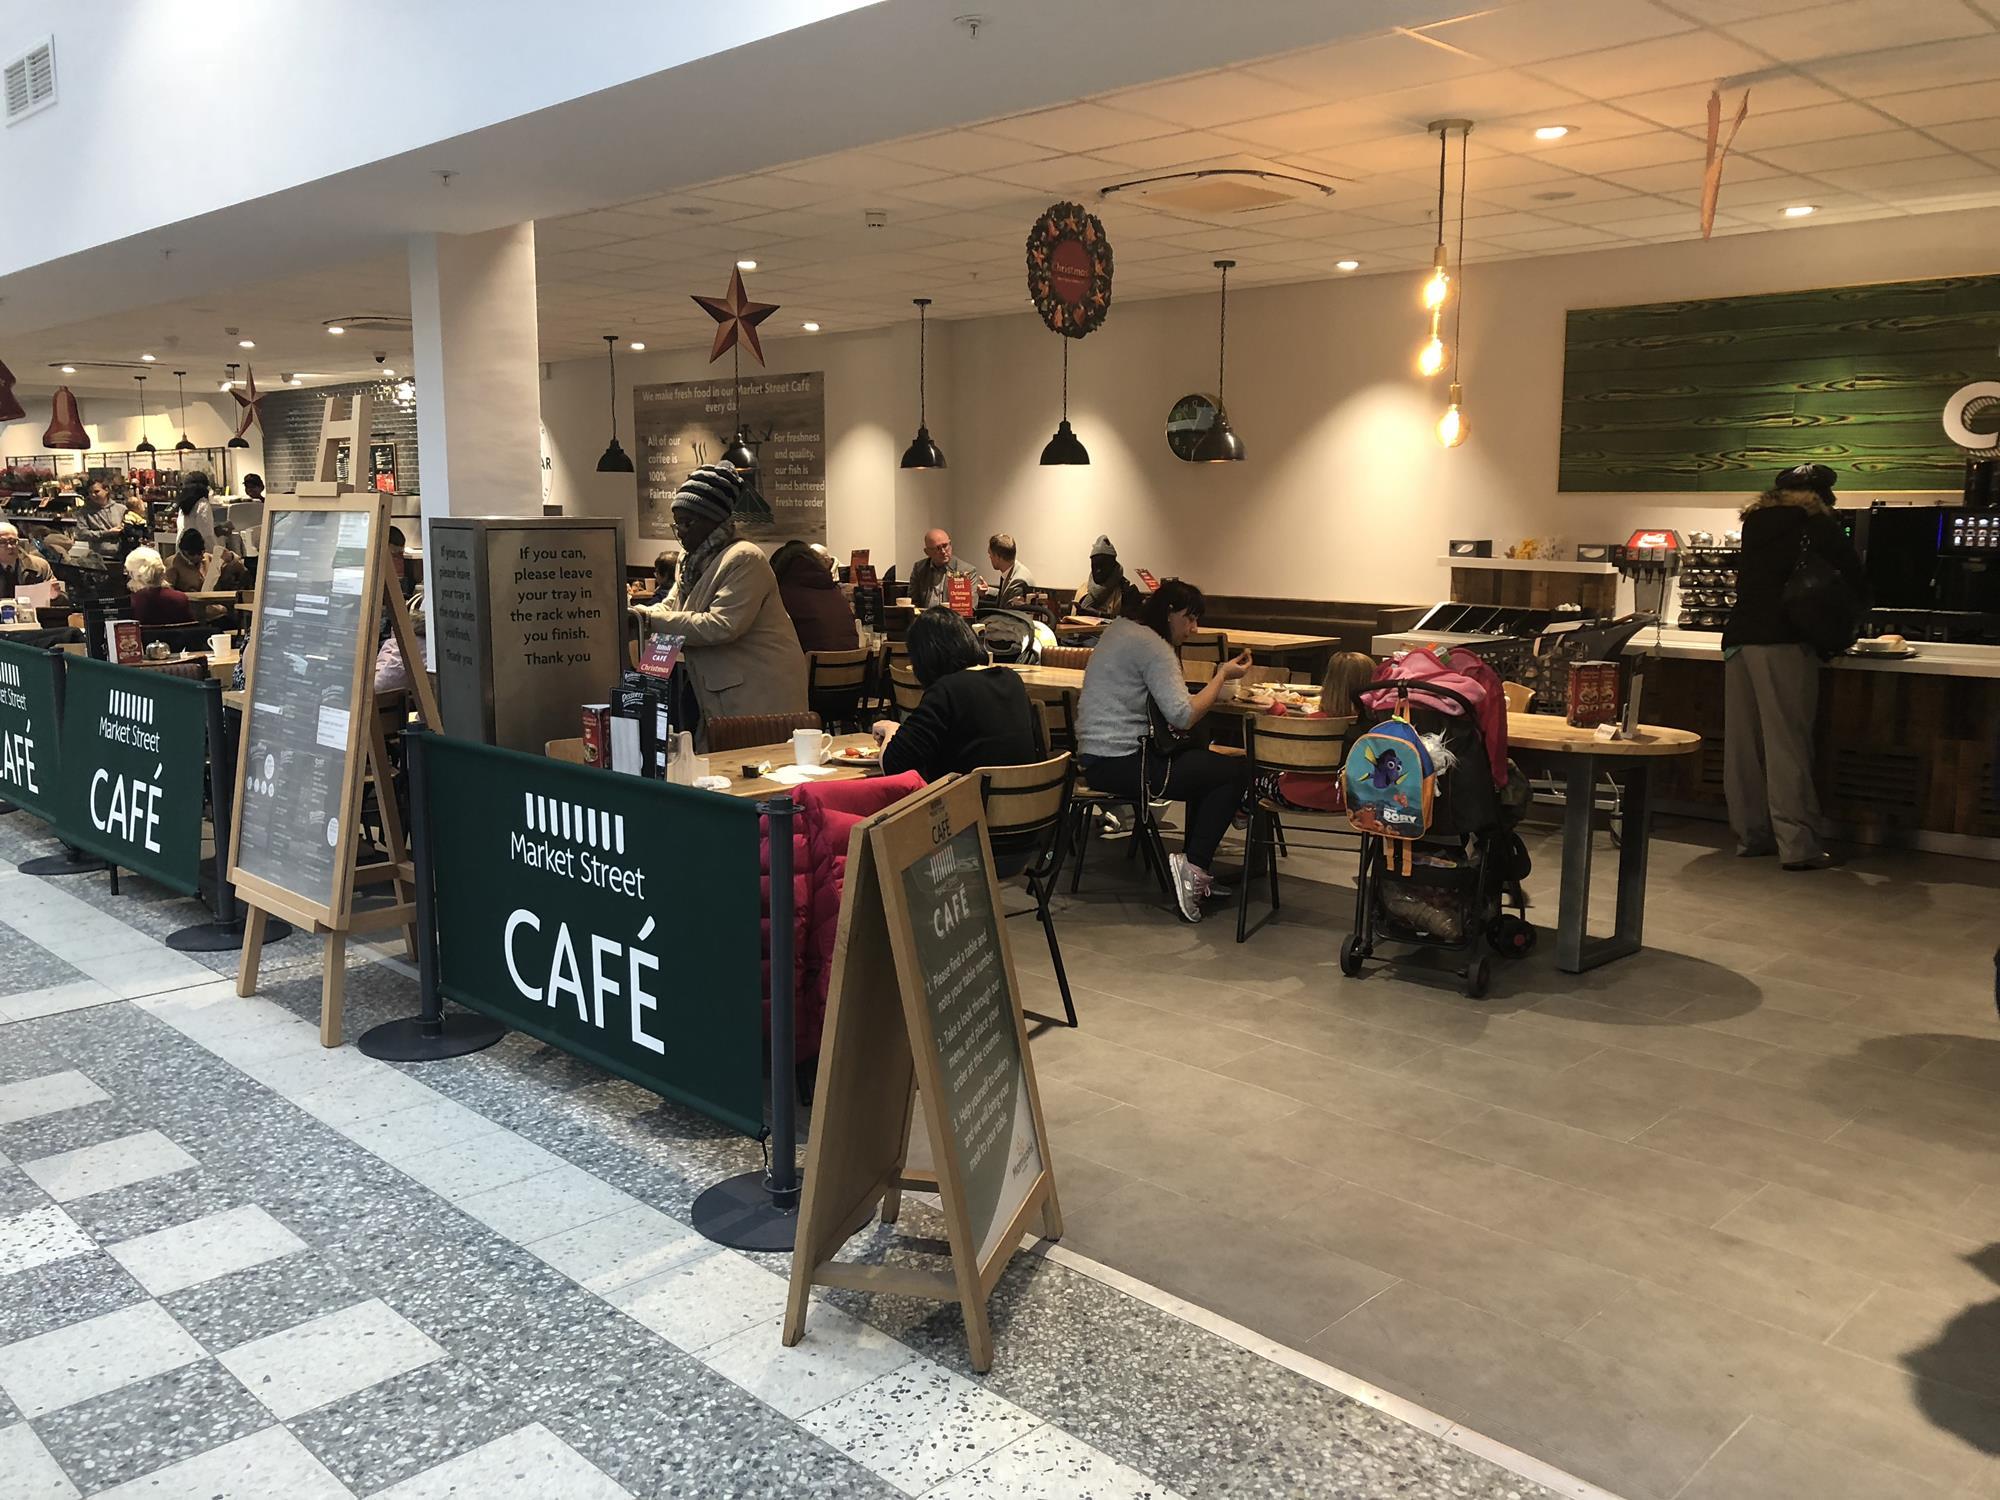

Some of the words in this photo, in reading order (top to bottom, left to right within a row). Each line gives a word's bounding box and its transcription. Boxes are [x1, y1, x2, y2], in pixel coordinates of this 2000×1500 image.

[642, 391, 654, 401] We
[654, 389, 673, 400] make
[674, 387, 692, 400] fresh
[694, 385, 712, 399] food
[712, 386, 720, 397] in
[720, 386, 734, 397] our
[765, 380, 790, 393] Street
[791, 379, 810, 392] Café
[705, 404, 725, 414] every
[726, 402, 740, 413] da
[648, 436, 658, 447] All
[659, 435, 668, 446] of
[668, 436, 681, 446] our
[774, 433, 785, 443] For
[786, 432, 820, 442] freshness
[648, 453, 671, 465] coffee
[671, 454, 678, 464] is
[774, 449, 788, 458] and
[649, 470, 667, 482] 100%
[775, 468, 787, 476] our
[788, 464, 802, 475] fish
[802, 464, 809, 475] is
[650, 488, 677, 500] Fairtrad
[775, 481, 794, 492] hand
[794, 480, 825, 492] battered
[775, 496, 794, 507] fresh
[794, 498, 804, 507] to
[804, 496, 824, 508] order
[520, 547, 529, 560] If
[532, 552, 558, 562] you
[560, 548, 586, 560] can,
[514, 568, 556, 584] please
[560, 566, 593, 579] leave
[518, 590, 548, 604] your
[551, 589, 578, 602] tray
[580, 587, 592, 599] in
[510, 608, 533, 622] the
[536, 608, 564, 621] rack
[566, 606, 601, 619] when
[524, 632, 548, 646] you
[551, 626, 590, 640] finish.
[524, 651, 564, 666] Thank
[567, 652, 591, 666] you
[640, 664, 670, 674] Christmas
[8, 693, 28, 712] Street
[99, 716, 130, 745] Market
[132, 724, 160, 753] Street
[0, 718, 39, 794] AFÉ
[90, 762, 163, 854] CAFÉ
[511, 831, 575, 879] Market
[580, 852, 646, 900] Street
[933, 882, 970, 938] CAFÉ
[933, 966, 951, 990] Please
[950, 951, 961, 972] find
[961, 952, 966, 962] a
[964, 938, 978, 959] table
[978, 928, 988, 948] and
[504, 908, 665, 1055] CAFÉ
[938, 993, 952, 1014] note
[951, 981, 963, 1005] your
[962, 966, 976, 988] table
[944, 1024, 958, 1046] Take
[957, 1020, 962, 1032] a
[960, 1004, 973, 1028] look
[972, 985, 992, 1014] through
[992, 980, 1000, 994] our
[965, 1028, 976, 1051] and
[974, 1017, 988, 1043] place
[988, 1005, 1000, 1029] your
[954, 1069, 968, 1093] order
[968, 1060, 974, 1076] at
[974, 1050, 983, 1068] the
[959, 1102, 972, 1124] Help
[971, 1075, 990, 1115] yourself
[988, 1074, 994, 1087] to
[964, 1123, 975, 1148] and
[974, 1120, 982, 1136] we
[980, 1103, 990, 1125] will
[988, 1093, 1000, 1116] bring
[1000, 1081, 1010, 1104] your
[969, 1144, 982, 1172] meal
[980, 1142, 986, 1156] to
[986, 1127, 997, 1153] your
